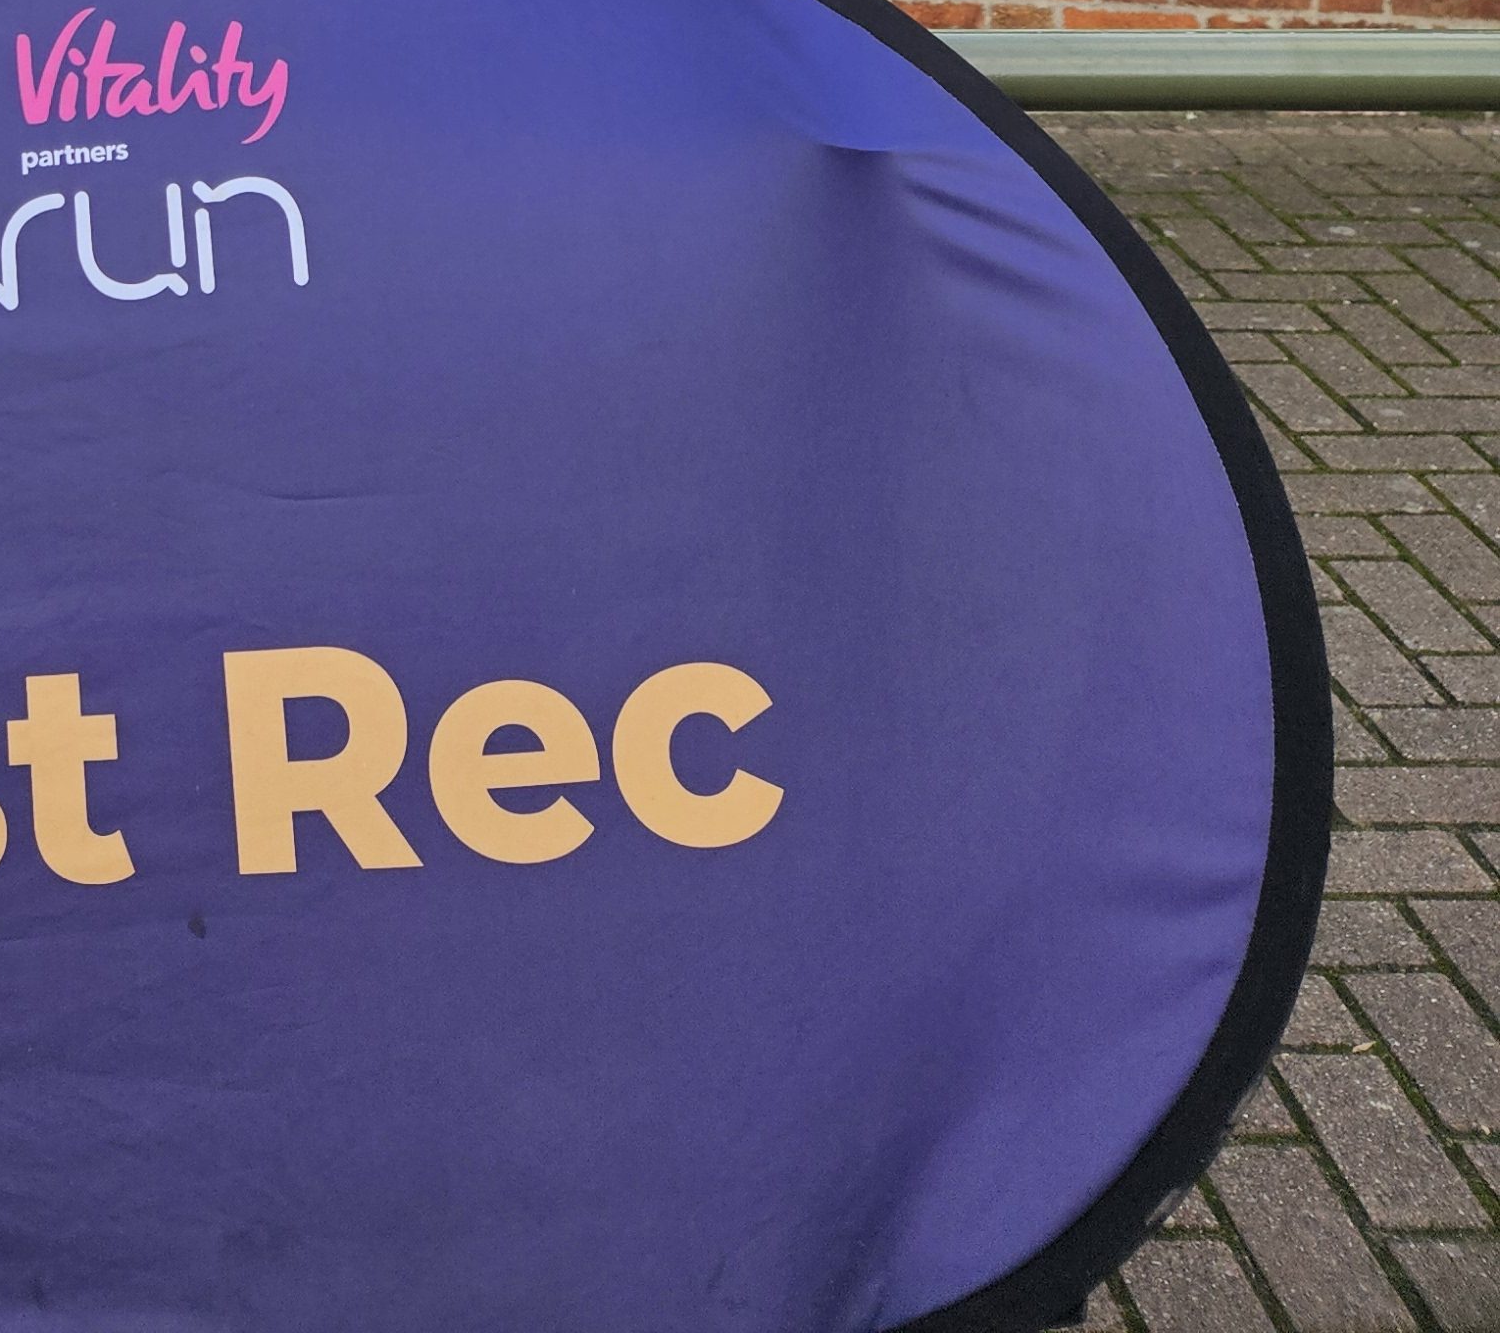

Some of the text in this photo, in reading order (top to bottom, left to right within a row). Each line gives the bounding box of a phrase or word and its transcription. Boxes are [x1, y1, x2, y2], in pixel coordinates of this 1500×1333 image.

[16, 7, 289, 145] Vitality
[20, 141, 130, 175] partners
[223, 645, 785, 875] Rec
